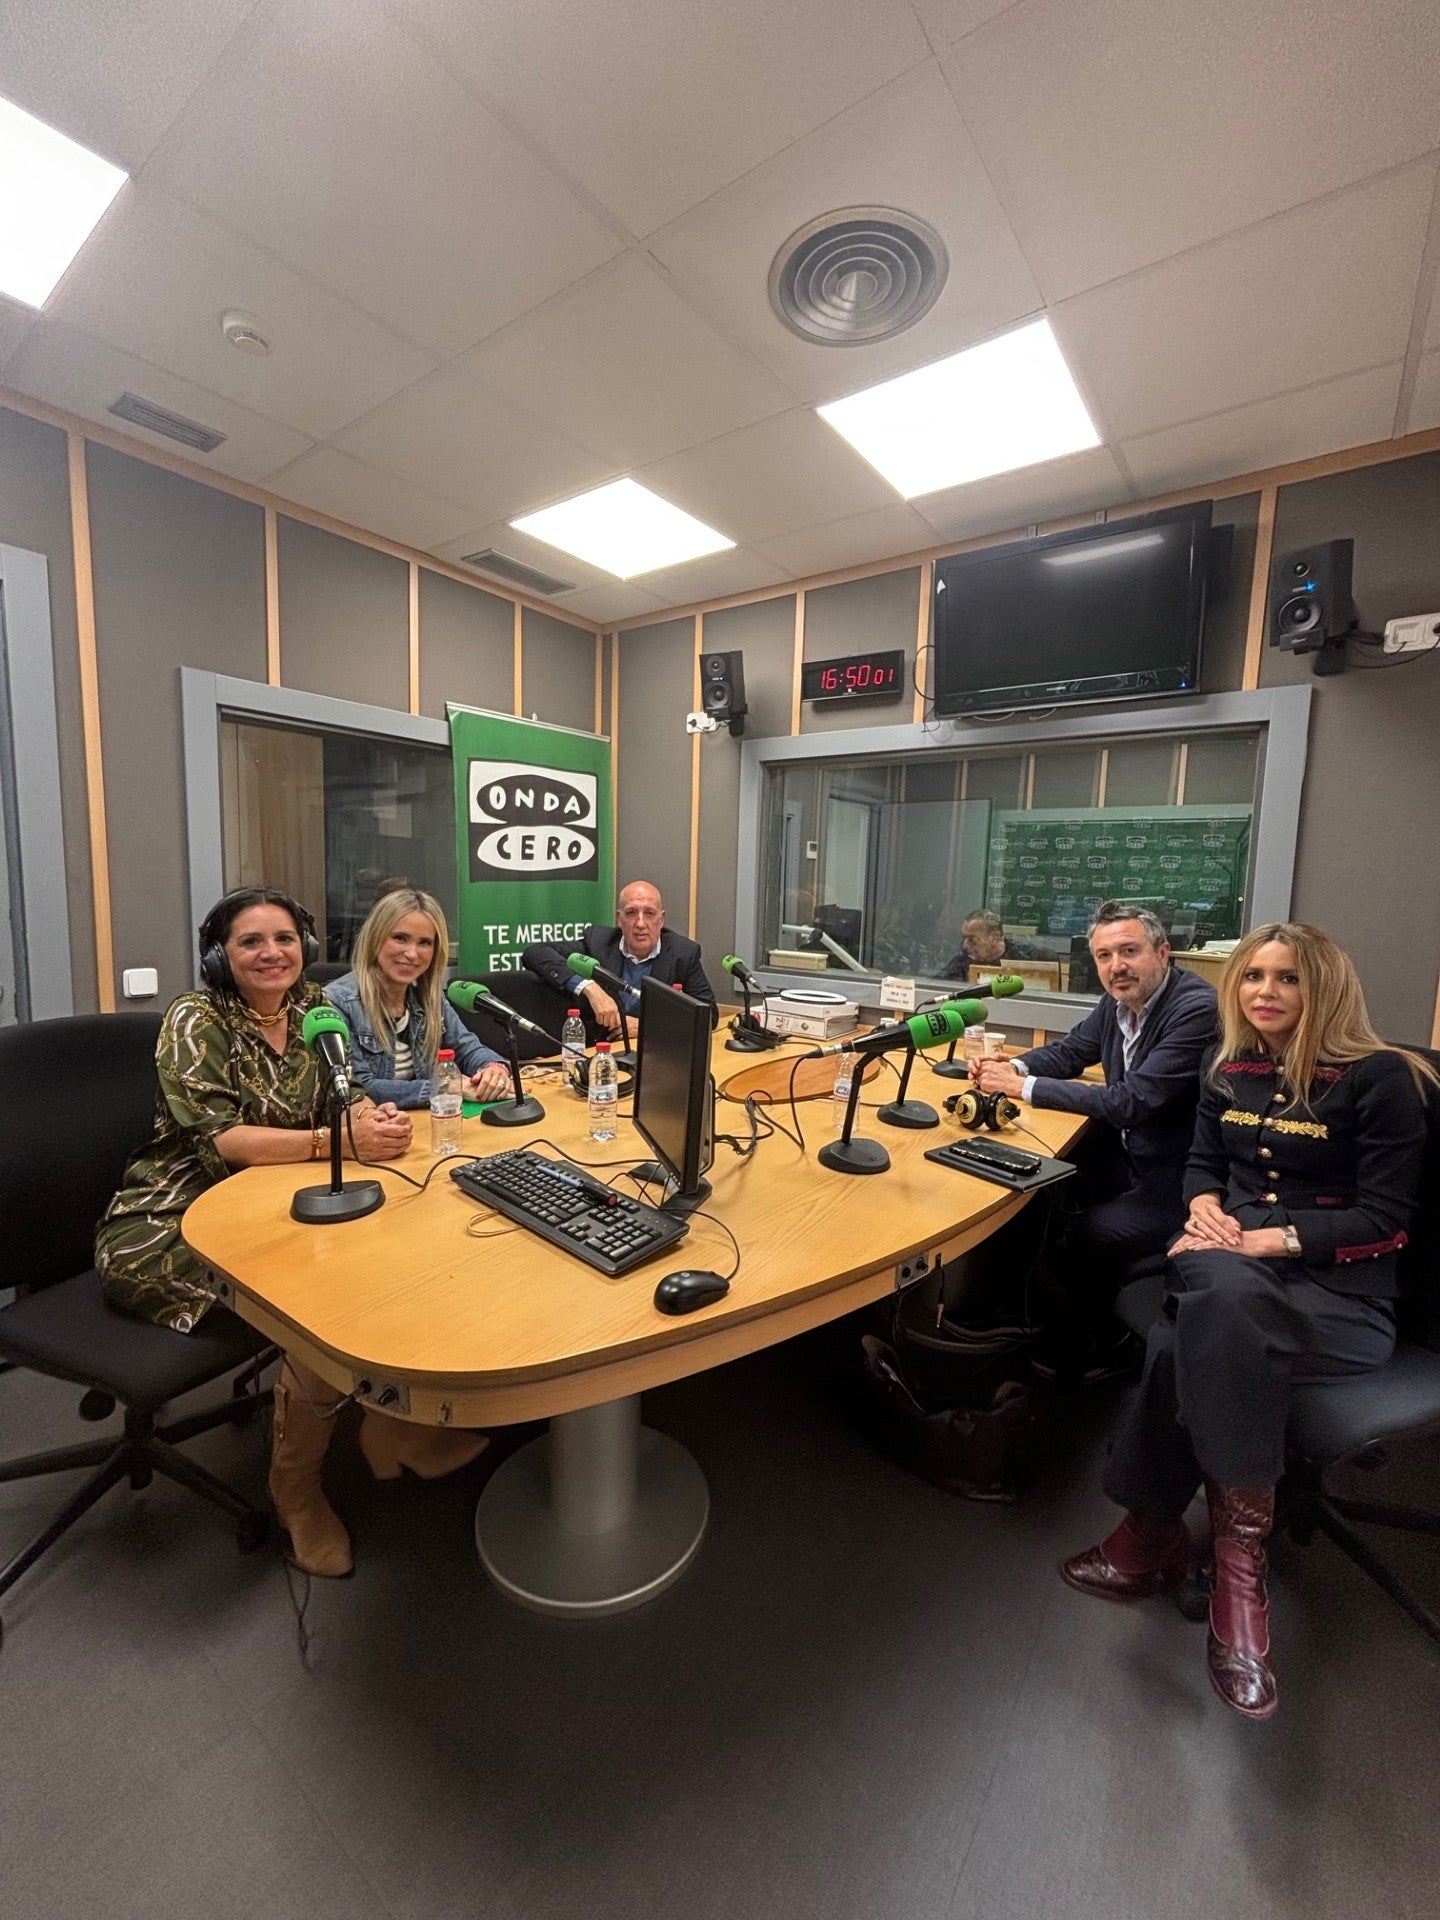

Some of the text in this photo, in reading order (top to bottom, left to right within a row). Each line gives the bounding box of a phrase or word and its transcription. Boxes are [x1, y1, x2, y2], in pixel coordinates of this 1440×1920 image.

[821, 664, 894, 690] 16:50 01
[489, 785, 581, 815] ONDA
[496, 833, 582, 861] CERO
[483, 925, 510, 945] TE
[489, 952, 526, 973] EST
